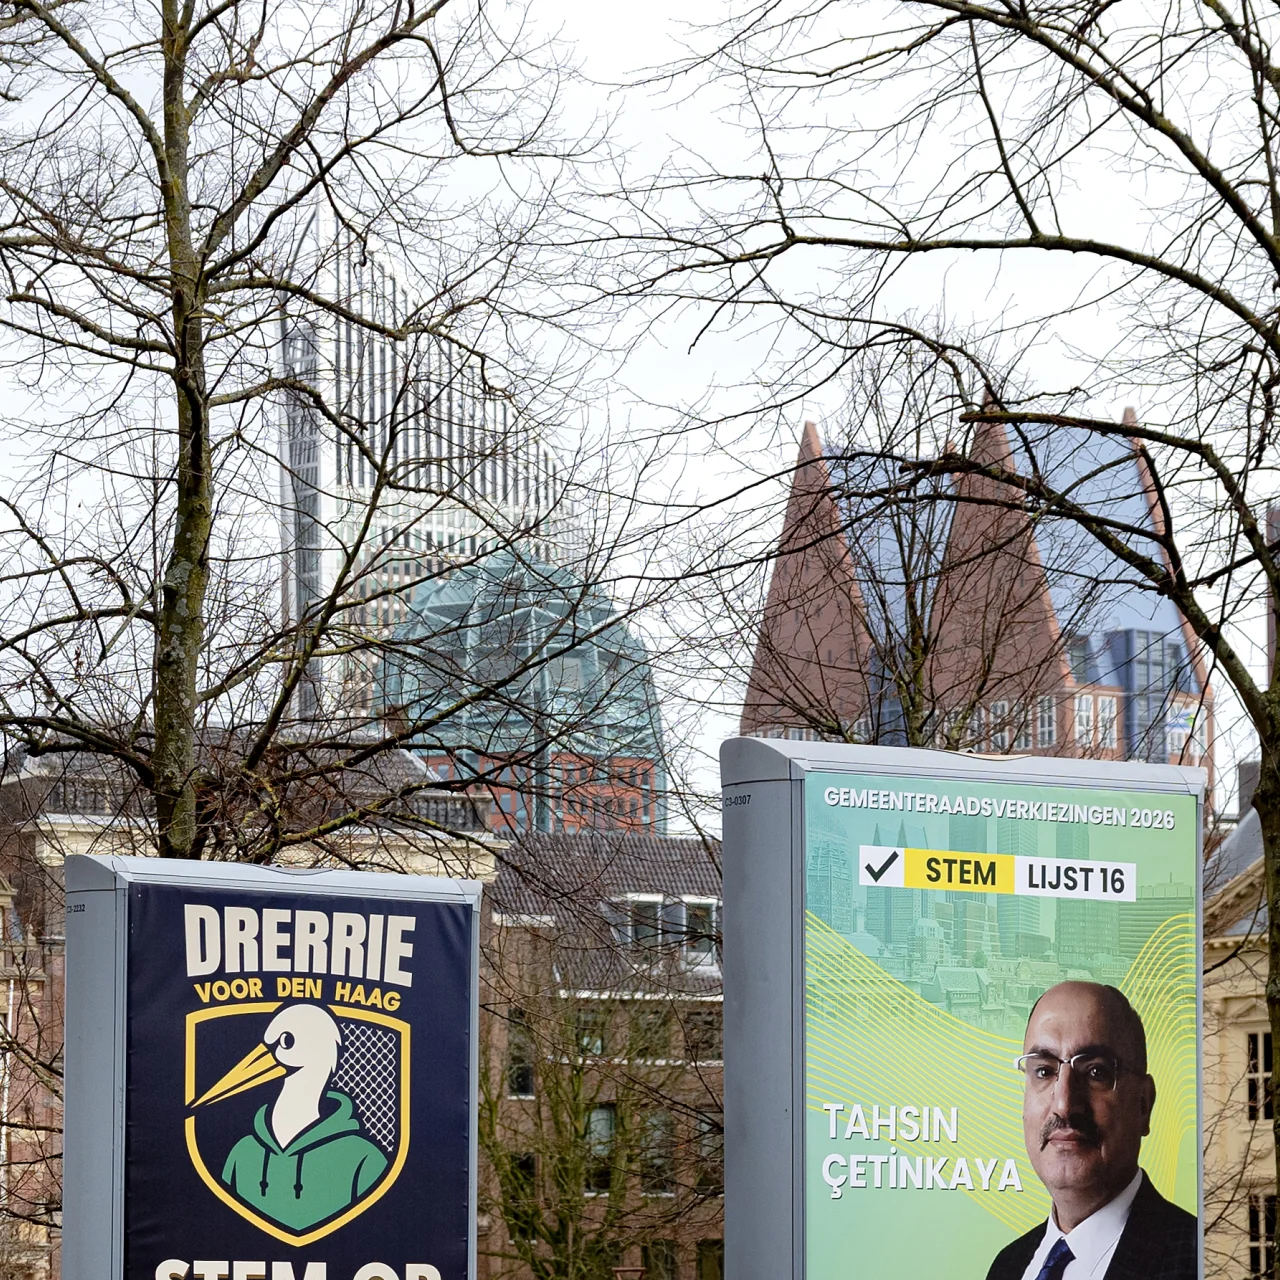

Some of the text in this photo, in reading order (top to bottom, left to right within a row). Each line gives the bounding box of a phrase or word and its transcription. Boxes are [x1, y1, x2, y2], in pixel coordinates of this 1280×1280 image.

[725, 795, 751, 807] C3-0307
[824, 787, 1175, 830] GEMEENTERAADSVERKIEZINGEN 2026
[926, 857, 1125, 893] STEM LIJST 16
[184, 904, 416, 987] DRERRIE
[194, 977, 402, 1011] VOOR DEN HAAG
[823, 1103, 958, 1142] TAHSIN
